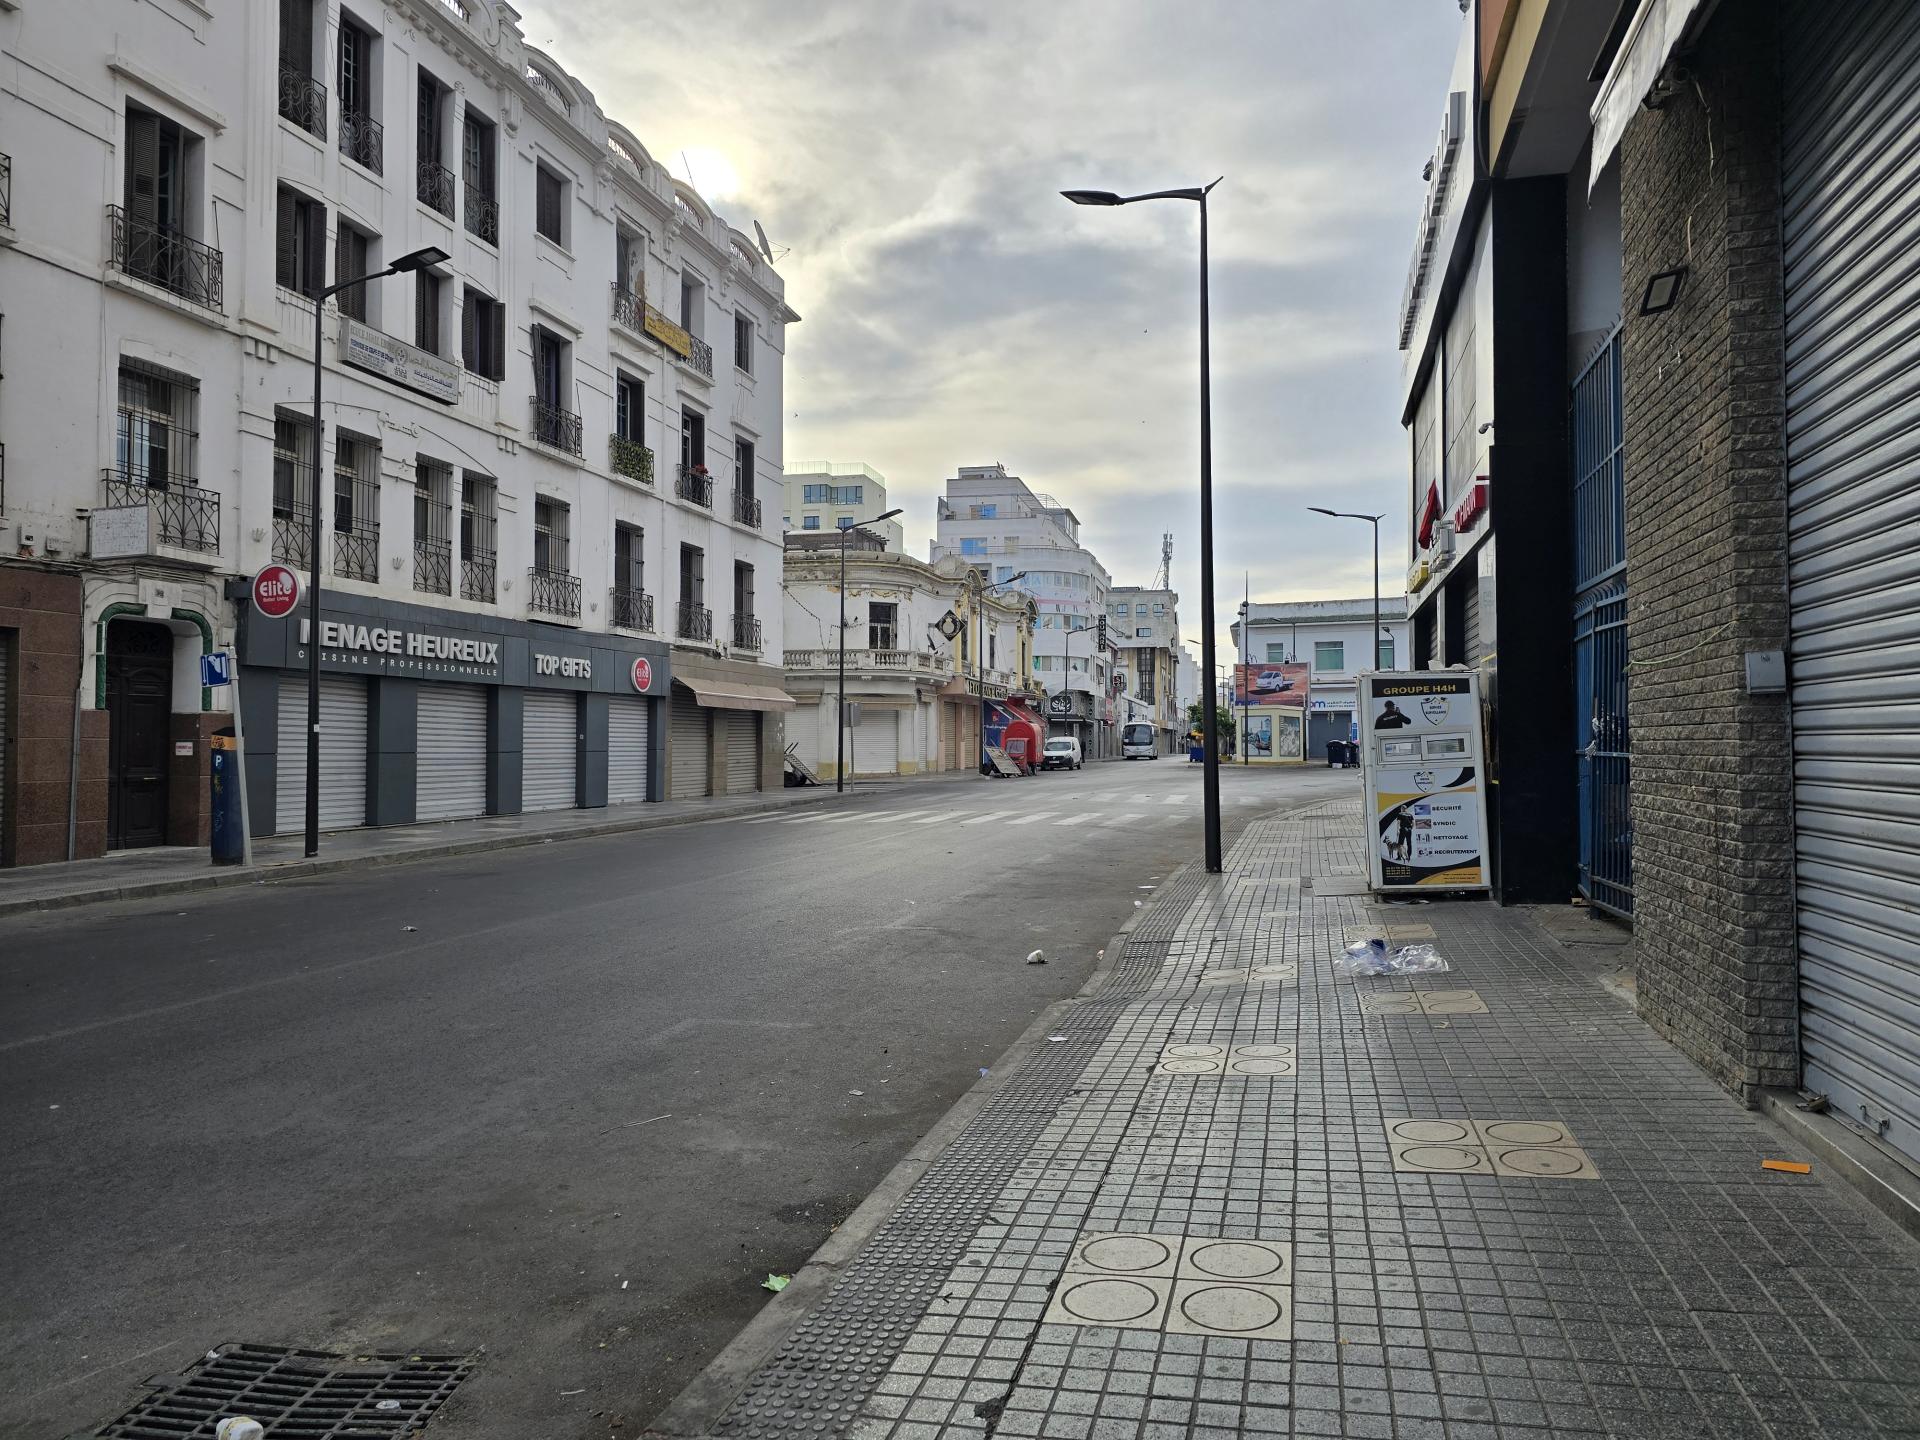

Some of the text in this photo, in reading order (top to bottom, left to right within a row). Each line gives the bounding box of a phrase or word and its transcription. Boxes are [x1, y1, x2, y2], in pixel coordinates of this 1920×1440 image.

[407, 632, 498, 664] HEUREUX
[298, 650, 497, 676] CISINE PROFESSIONNELLE
[534, 653, 592, 679] TOP GIFTS
[1383, 684, 1456, 695] GROUPE H4H
[215, 754, 222, 767] P
